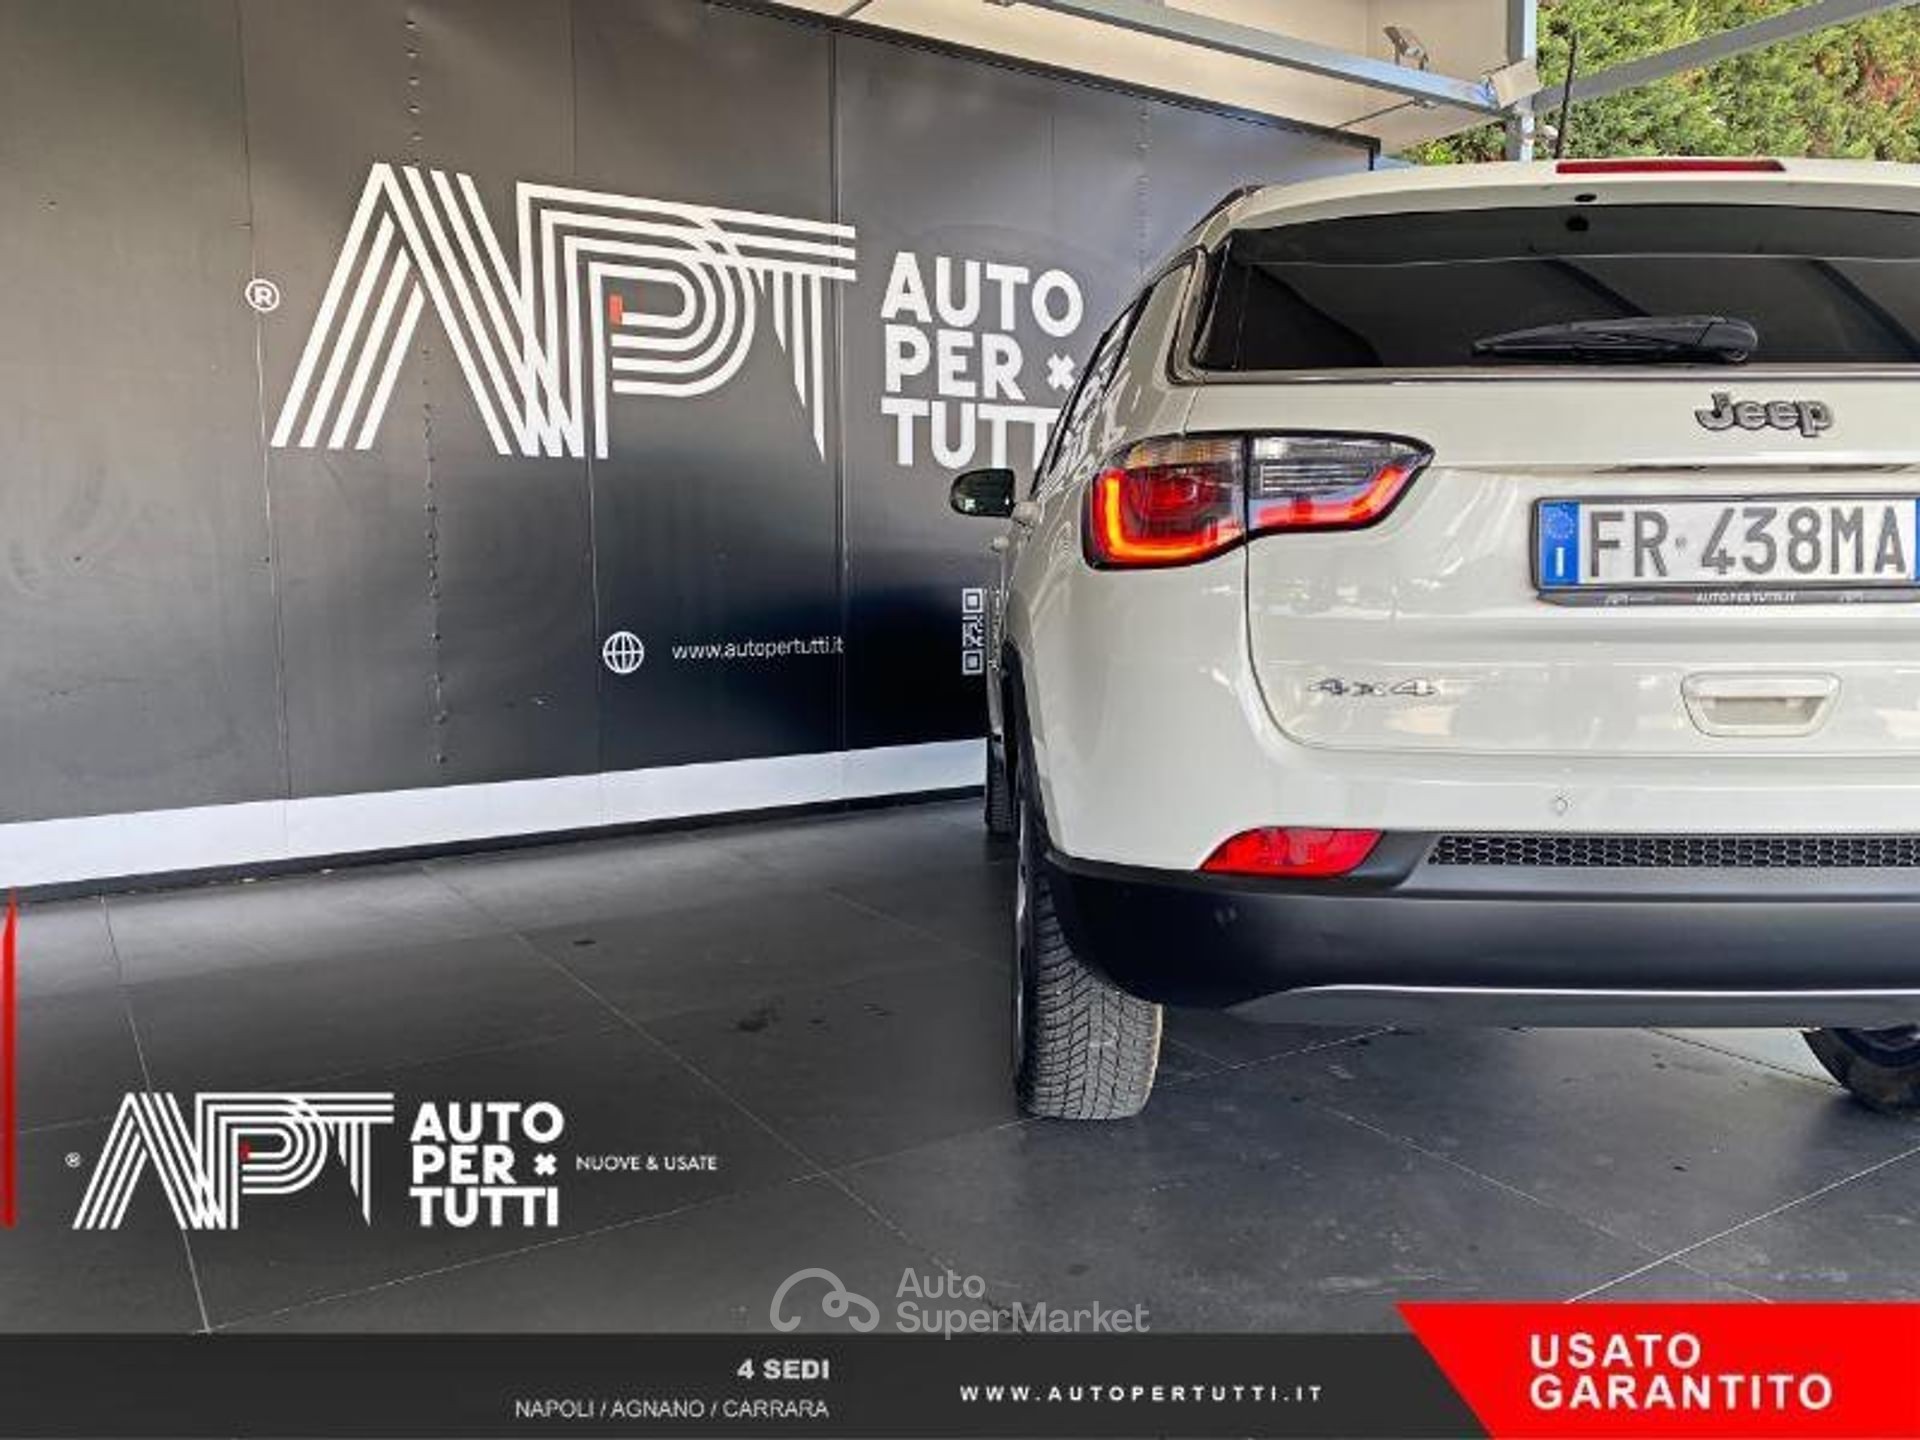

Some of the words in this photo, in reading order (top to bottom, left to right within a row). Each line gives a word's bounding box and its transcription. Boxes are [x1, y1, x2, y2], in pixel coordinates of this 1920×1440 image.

[881, 251, 1084, 338] AUTO
[885, 324, 1026, 400] PER
[881, 397, 1062, 470] TUTT
[1695, 391, 1833, 438] Jeep
[1589, 511, 1669, 578] FR
[1701, 506, 1907, 576] 438MA
[672, 635, 844, 659] www.autopertutti.it
